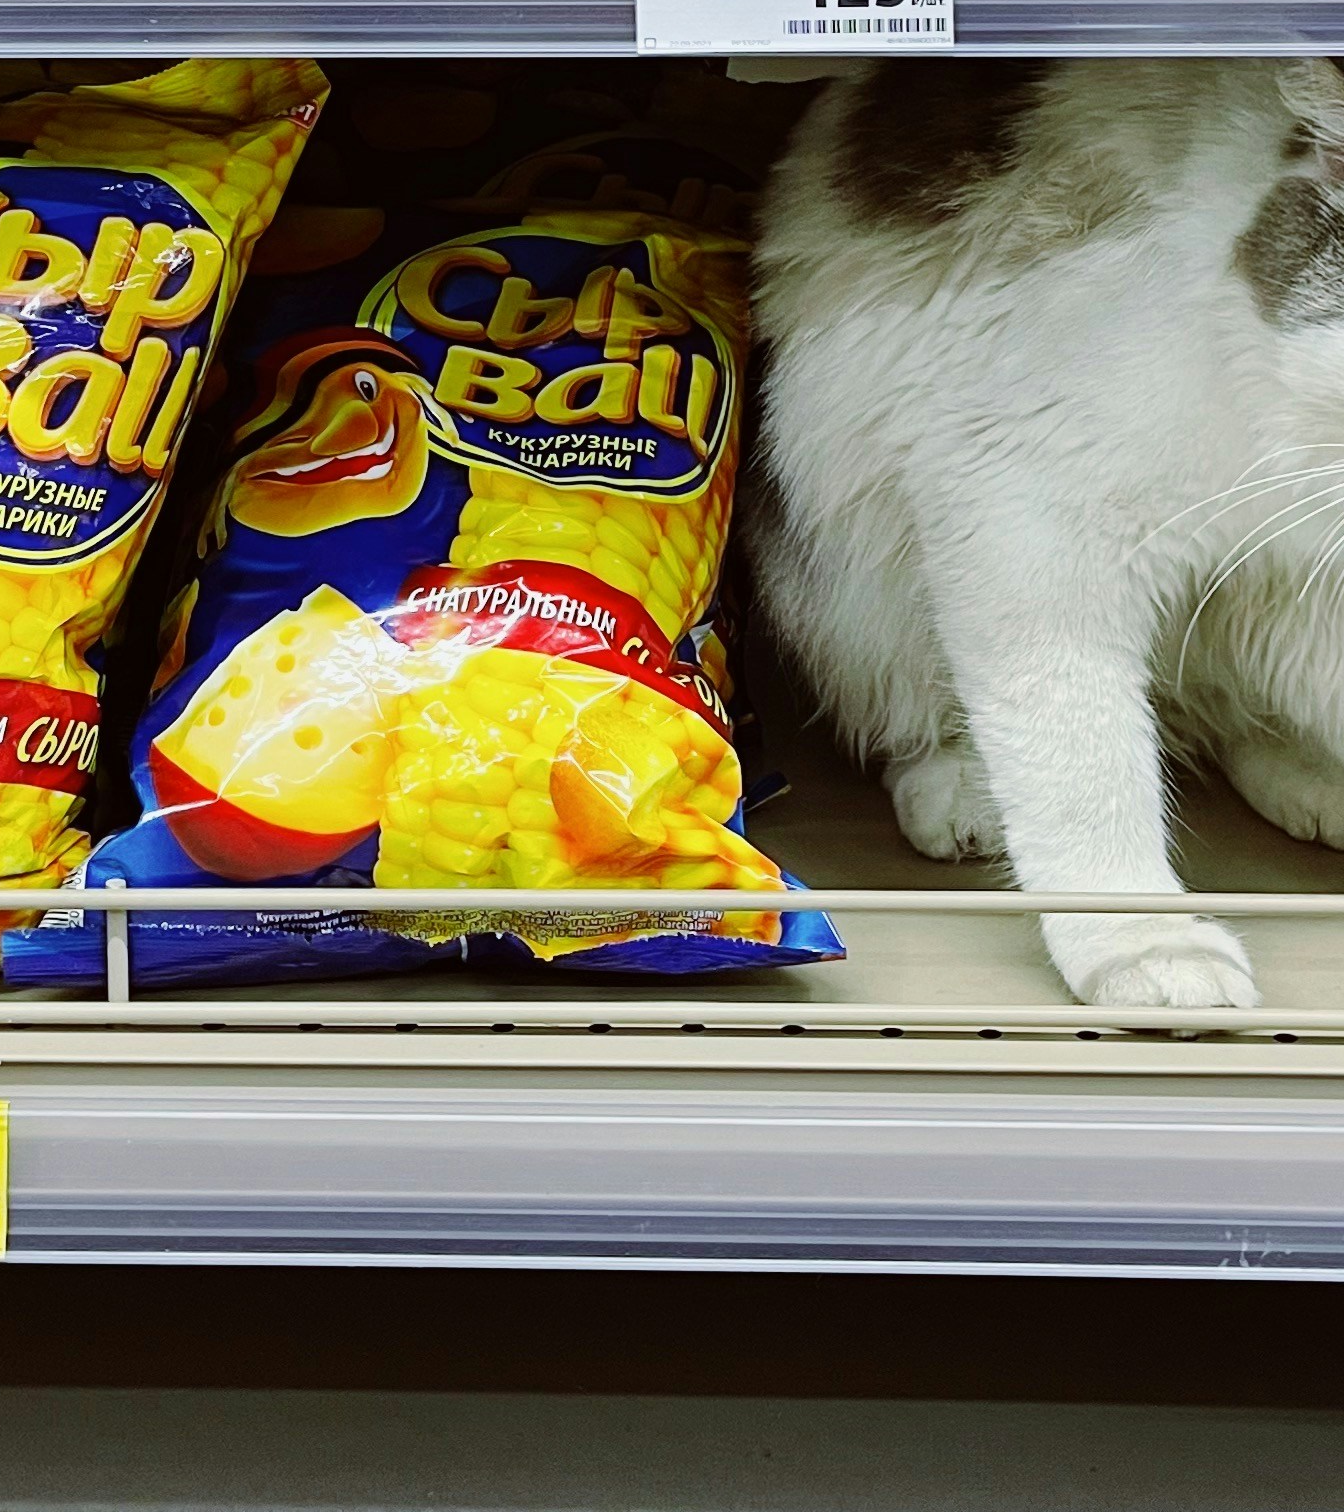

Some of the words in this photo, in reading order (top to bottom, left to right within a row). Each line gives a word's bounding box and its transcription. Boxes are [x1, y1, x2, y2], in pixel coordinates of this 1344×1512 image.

[395, 244, 692, 362] Сыр
[432, 343, 719, 462] Ball
[487, 428, 658, 459] КУКУРУЗНЫЕ
[519, 449, 633, 473] ШАРИКИ
[423, 584, 618, 640] НАТУРАЛЬНЫМ
[15, 715, 98, 776] СЫРО
